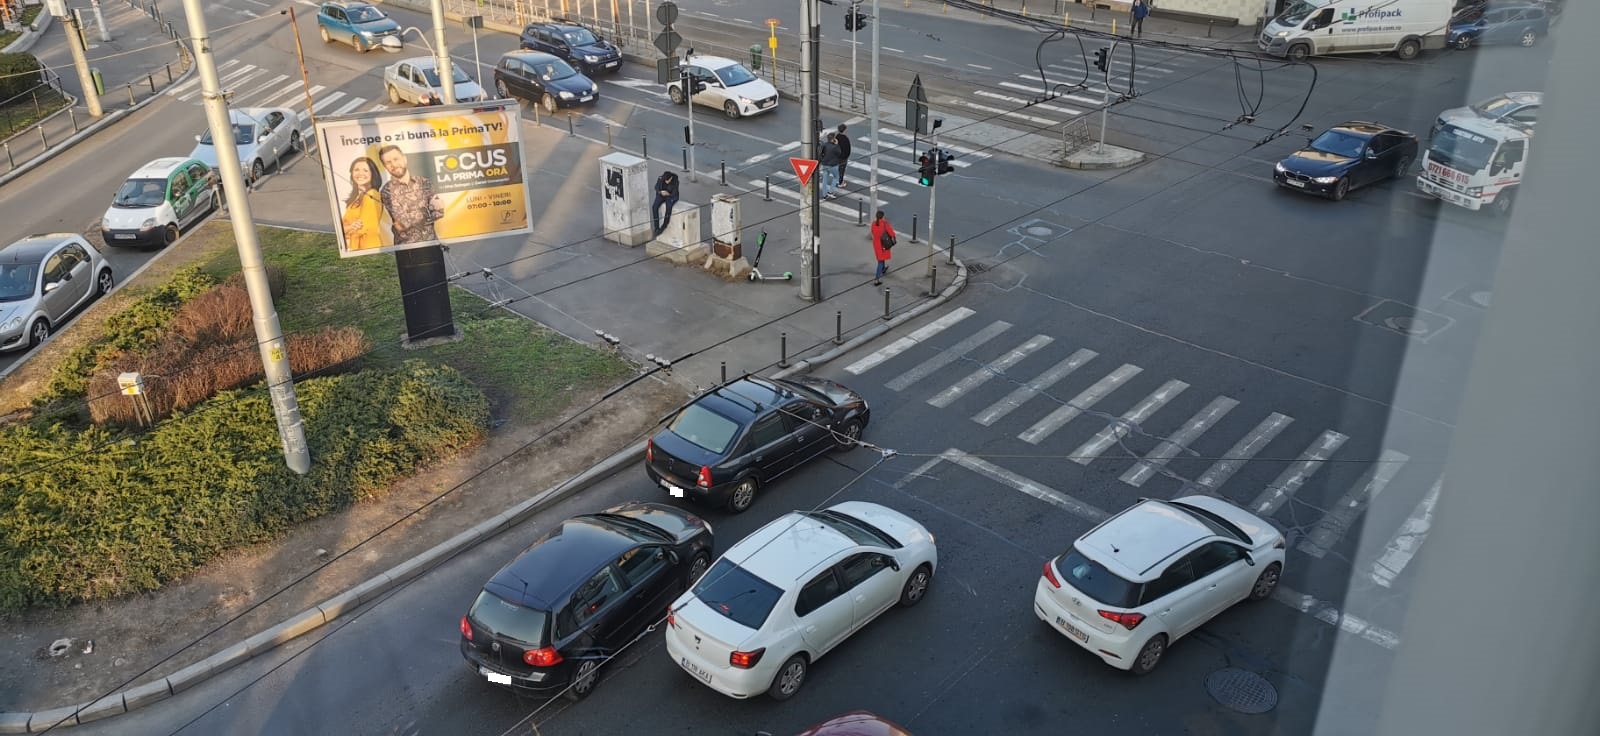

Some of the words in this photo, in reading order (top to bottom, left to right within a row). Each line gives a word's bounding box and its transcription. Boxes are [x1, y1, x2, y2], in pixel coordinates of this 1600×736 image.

[1360, 8, 1402, 20] Profipack
[340, 134, 382, 146] Începe
[394, 131, 405, 141] zi
[407, 128, 436, 140] bună
[439, 128, 449, 137] la
[451, 122, 503, 136] PrimaTV!
[434, 148, 508, 173] FOCUS
[437, 173, 452, 183] LA
[452, 170, 485, 181] PRIMA
[485, 165, 508, 177] ORĂ
[466, 195, 481, 203] LUNI
[487, 191, 512, 200] VINERI
[467, 202, 488, 210] 07:00
[492, 199, 512, 207] 10:00
